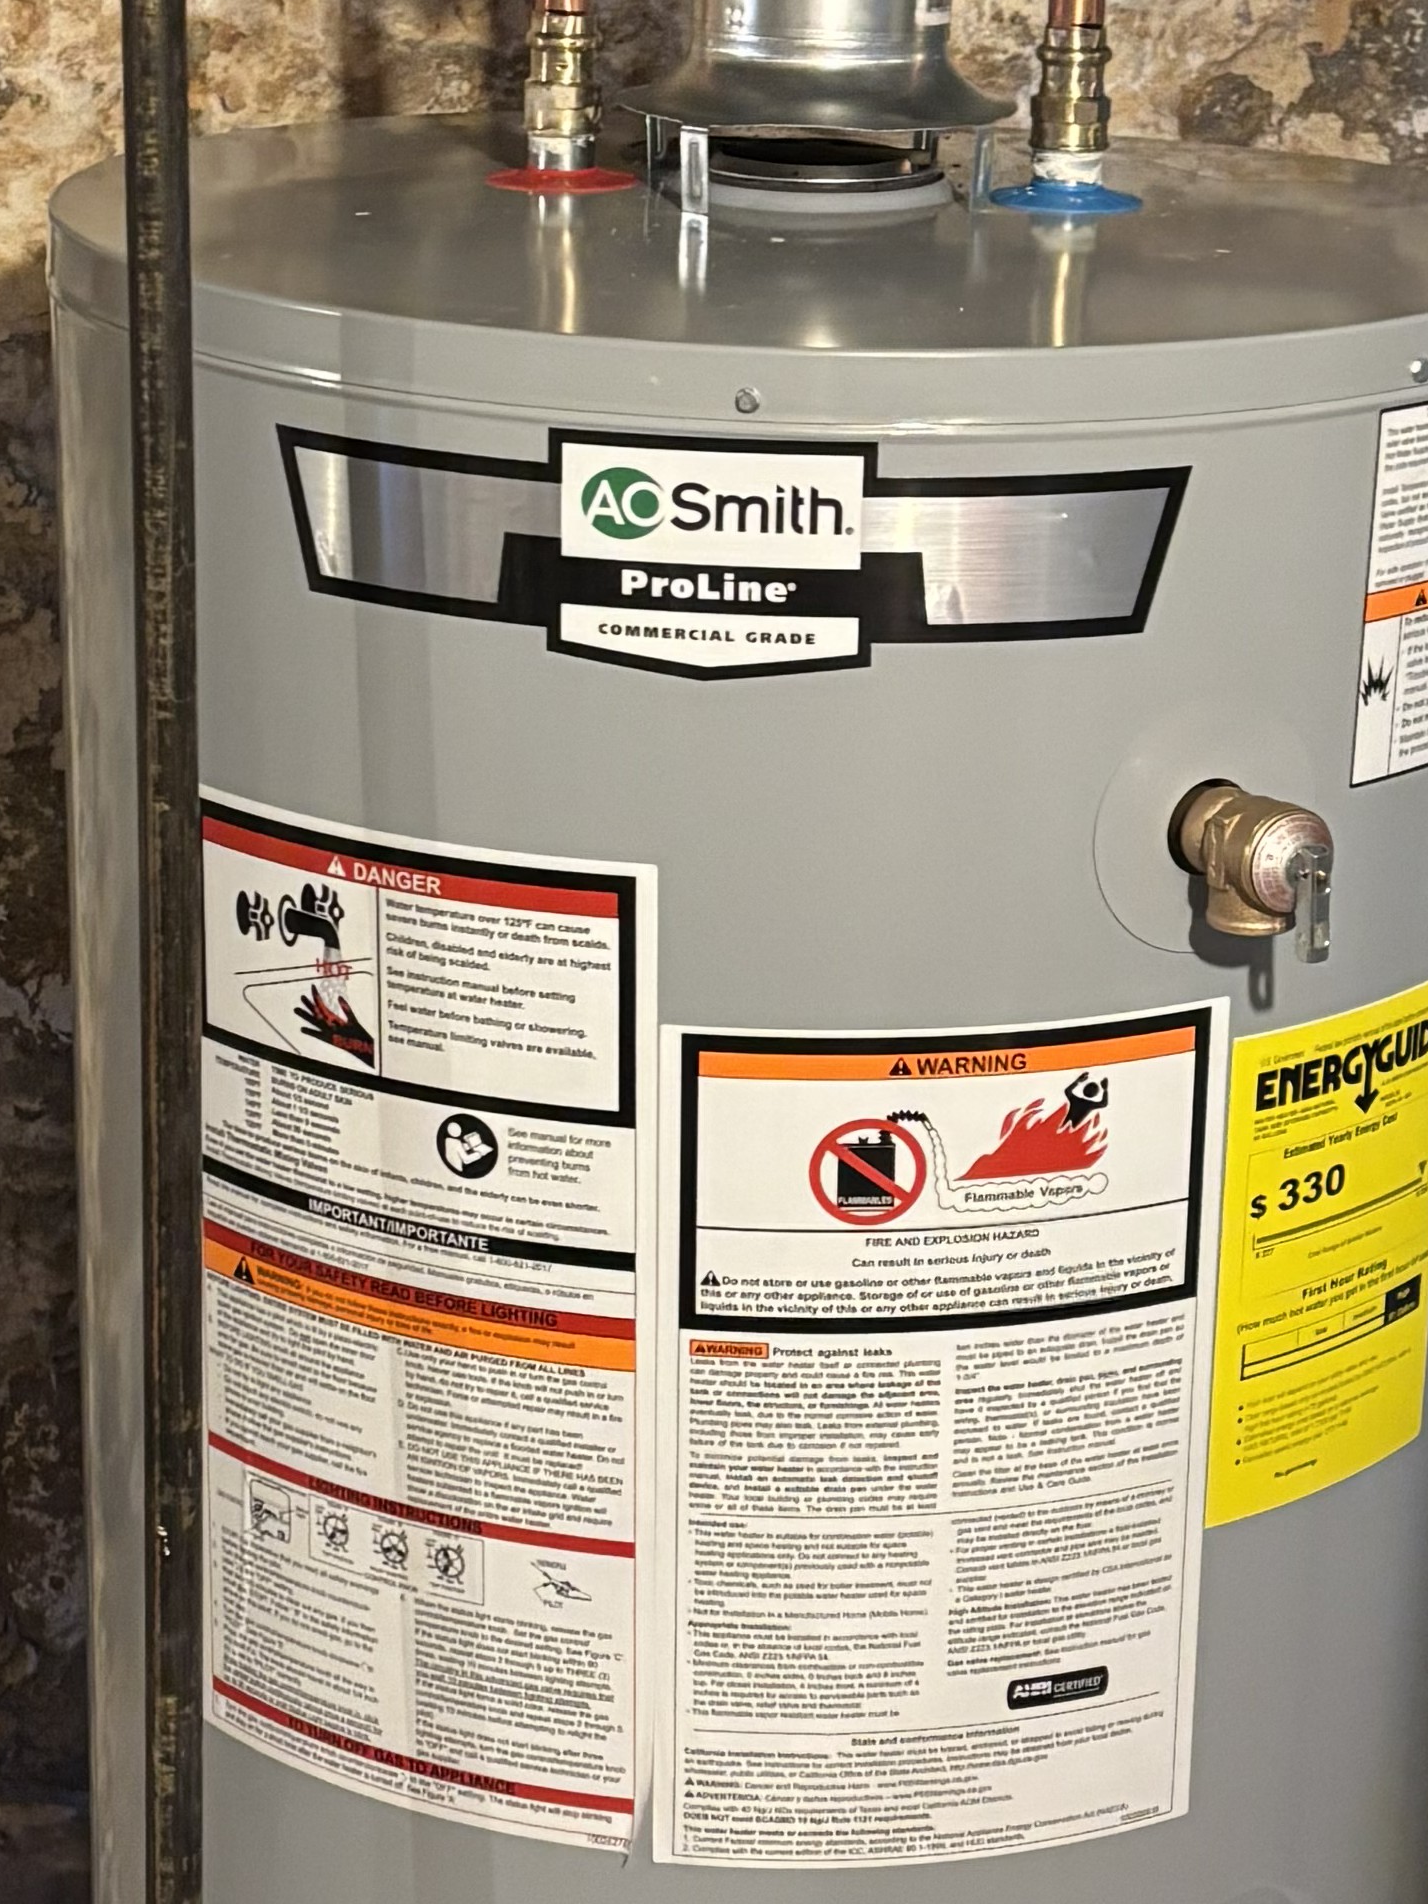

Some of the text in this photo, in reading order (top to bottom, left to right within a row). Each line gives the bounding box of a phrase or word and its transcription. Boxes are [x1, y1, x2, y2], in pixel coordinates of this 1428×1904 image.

[598, 623, 816, 645] COMMERCIAL GRADE
[353, 862, 441, 895] DANGER
[385, 898, 413, 911] Water
[415, 904, 475, 921] temperature
[478, 914, 501, 925] over
[535, 922, 555, 931] can
[558, 923, 591, 934] cause
[917, 1053, 1028, 1075] WARNING
[507, 1127, 612, 1148] See manual for more
[1328, 1129, 1352, 1146] Yearly
[1355, 1119, 1381, 1137] Energy
[1382, 1112, 1398, 1127] Cost
[507, 1141, 594, 1160] information about
[507, 1155, 591, 1172] preventing burns
[508, 1166, 582, 1185] from hot water.
[964, 1185, 1084, 1203] Flammable Vapors
[1250, 1164, 1345, 1220] $ 330
[308, 1197, 490, 1252] IMPORTANT/IMPORTANTE
[865, 1229, 1040, 1247] FIRE AND EXPLOSION HAZARD
[722, 1248, 1176, 1290] Do not store or use gasoline or other flammable vapors and liquids in the vicinity of
[852, 1248, 1051, 1267] Can result in serious injury or death
[250, 1241, 558, 1327] FOR YOUR SAFETY READ BEFORE LIGHTING
[701, 1288, 722, 1298] this
[725, 1289, 737, 1298] or
[740, 1290, 762, 1301] any
[764, 1290, 794, 1301] other
[859, 1290, 903, 1302] Storage
[906, 1289, 919, 1299] of
[922, 1289, 934, 1298] or
[935, 1288, 957, 1298] use
[959, 1287, 971, 1297] of
[973, 1285, 1020, 1297] gasoline
[1023, 1283, 1035, 1292] or
[1037, 1278, 1065, 1290] other
[1123, 1265, 1158, 1279] vapors
[1159, 1263, 1170, 1272] or
[1302, 1259, 1388, 1299] First Hour Rating
[700, 1301, 739, 1312] liquids
[742, 1302, 753, 1312] in
[756, 1302, 774, 1313] the
[777, 1303, 818, 1315] vicinity
[821, 1302, 834, 1313] of
[836, 1302, 857, 1313] this
[860, 1304, 873, 1313] or
[875, 1303, 896, 1314] any
[899, 1302, 929, 1312] other
[932, 1298, 986, 1312] appliance
[989, 1298, 1009, 1307] can
[1130, 1280, 1142, 1289] or
[705, 1345, 763, 1356] WARNING
[772, 1347, 893, 1358] Protect against leaks
[408, 1757, 426, 1773] TO
[430, 1762, 515, 1796] APPLIANCE
